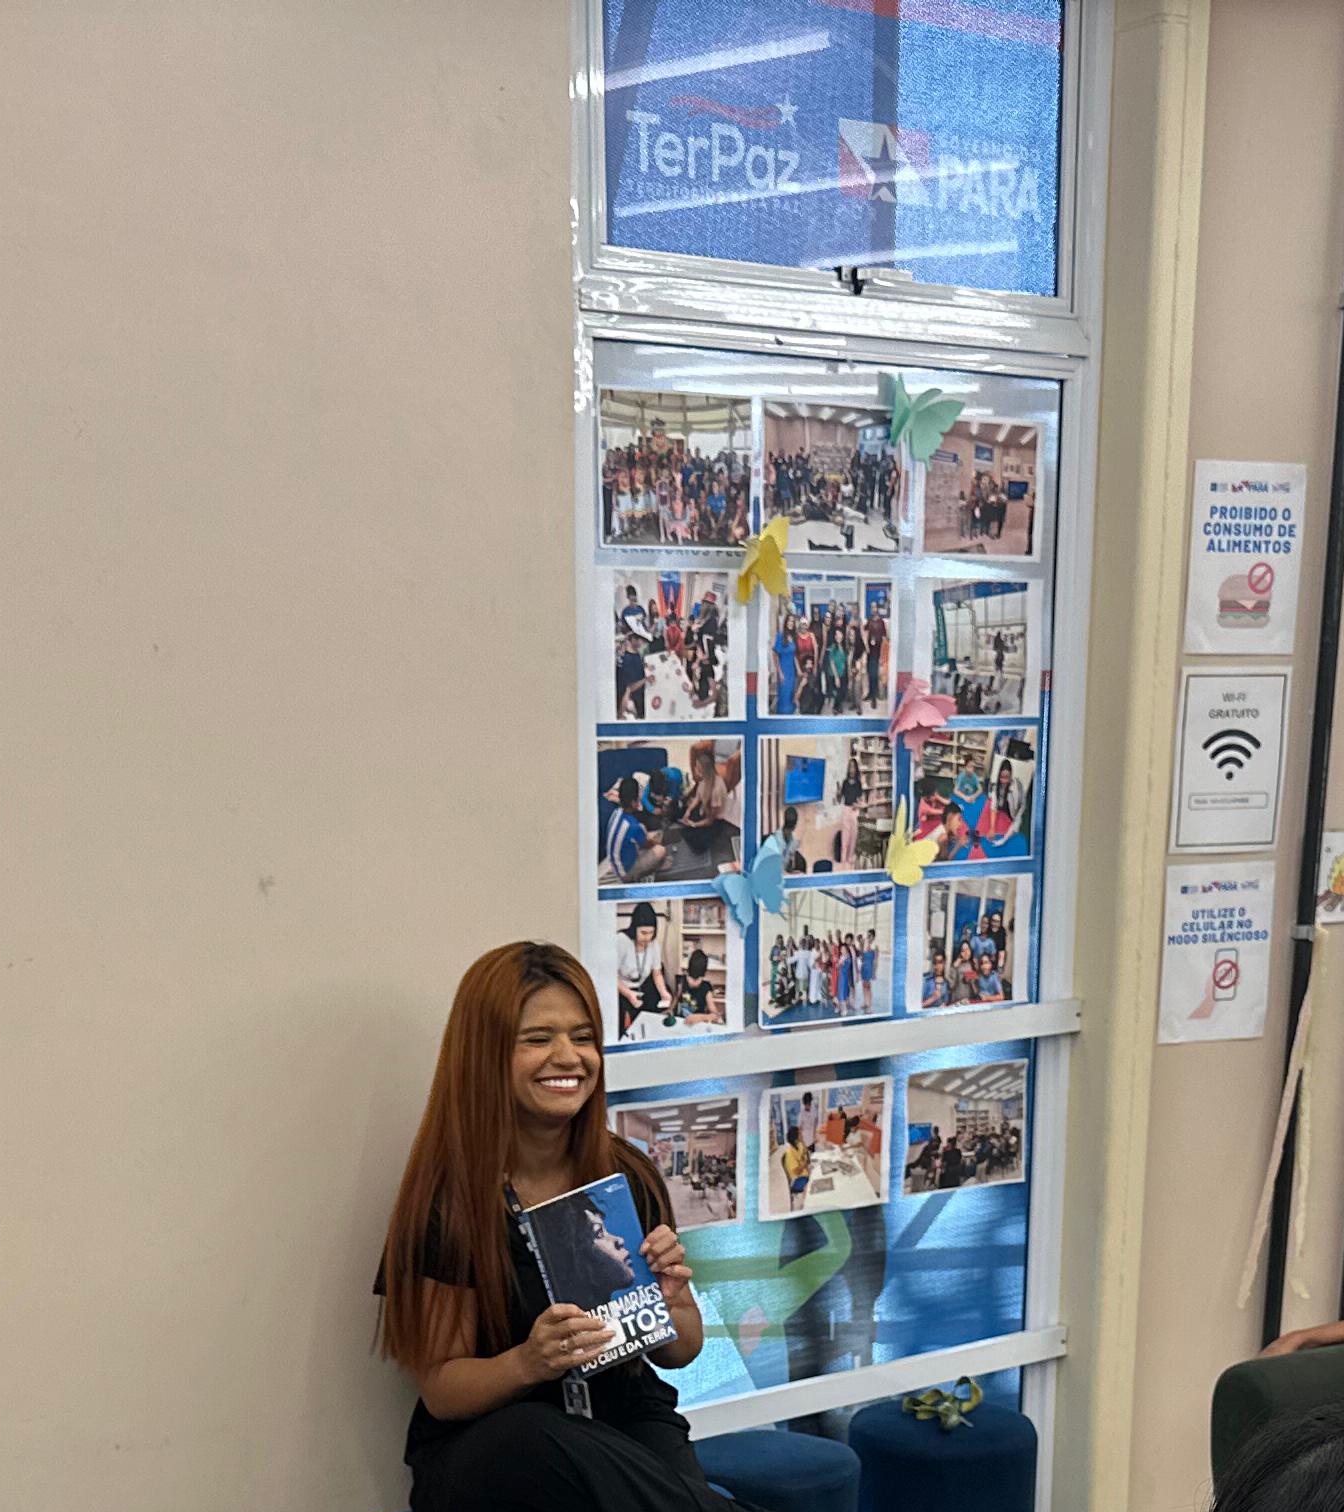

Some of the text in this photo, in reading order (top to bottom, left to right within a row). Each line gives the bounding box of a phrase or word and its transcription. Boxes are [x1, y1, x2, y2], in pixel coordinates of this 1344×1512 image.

[625, 109, 801, 192] TerPaz
[1209, 505, 1292, 521] PROIBIDO O
[1203, 521, 1297, 538] CONSUMO DE
[1206, 537, 1292, 554] ALIMENTOS
[1208, 707, 1261, 719] GRATUITO
[1191, 906, 1246, 920] UTILIZE O
[1181, 918, 1253, 933] CELULAR NO
[1167, 933, 1199, 945] MODO
[597, 1282, 664, 1323] GUIMARÃES
[625, 1339, 644, 1354] DA
[641, 1325, 677, 1346] TERRA
